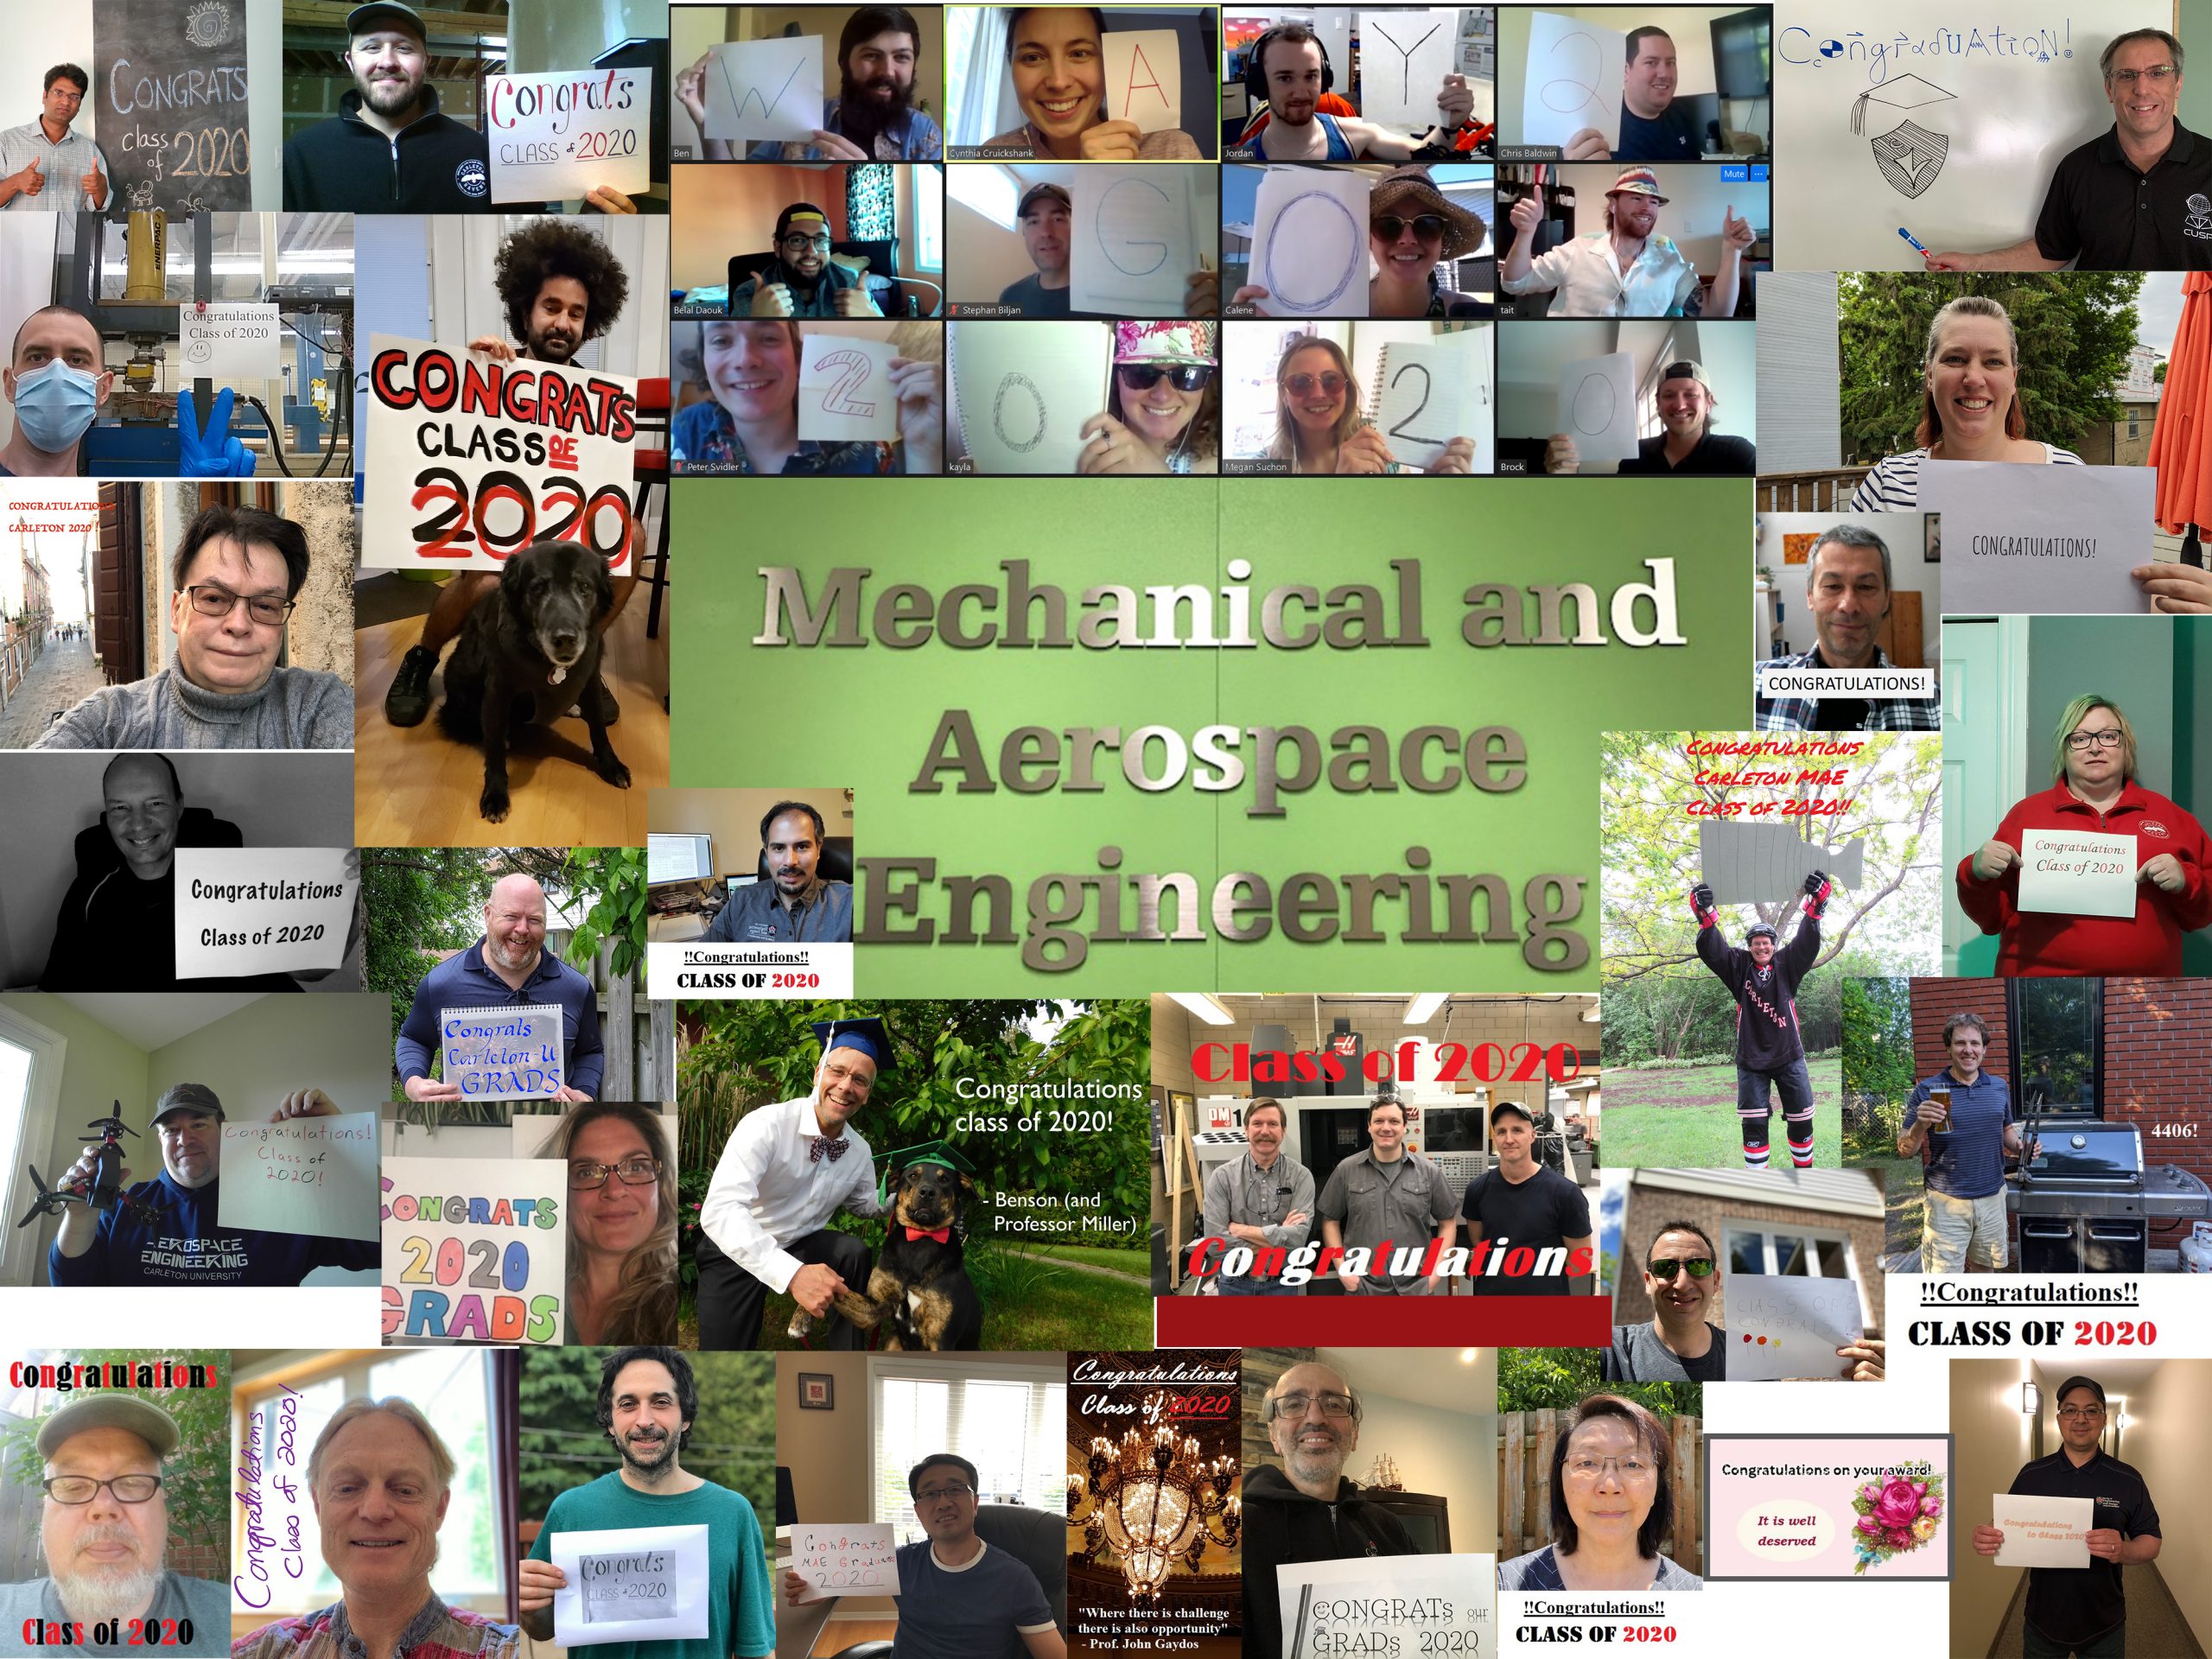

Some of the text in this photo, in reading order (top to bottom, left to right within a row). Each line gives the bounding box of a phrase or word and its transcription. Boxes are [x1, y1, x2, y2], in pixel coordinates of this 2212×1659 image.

[1372, 22, 1441, 105] Y
[1541, 32, 1611, 116] 2
[110, 58, 248, 114] CONGRATS
[721, 55, 806, 119] W
[1125, 44, 1170, 118] A
[492, 69, 636, 134] Congrats
[122, 124, 168, 151] class
[500, 129, 637, 164] CLASS of 2020
[172, 127, 251, 177] 2020
[949, 149, 1033, 159] Cynthia Cruickshank
[1225, 149, 1254, 157] Jordan
[1501, 149, 1557, 157] Chris Baldwin
[147, 150, 164, 181] of
[1724, 169, 1745, 178] Mute
[1096, 178, 1170, 276] G
[183, 309, 275, 326] Congratulations
[674, 306, 722, 315] Belal Daouk
[963, 306, 1021, 317] Stephan Biljan
[1225, 306, 1254, 315] Calene
[1500, 306, 1515, 315] tait
[189, 327, 269, 339] Class of 2020
[814, 350, 876, 417] 2
[372, 349, 636, 443] CONGRATS
[1389, 363, 1447, 448] 2
[417, 422, 580, 466] CLASS OF
[949, 463, 970, 473] kayla
[1225, 463, 1287, 473] Megan Suchon
[411, 467, 632, 569] 2020
[1973, 535, 2097, 558] CONGRATULATIONS!
[753, 556, 1688, 650] Mechanical and
[909, 709, 1529, 819] Aerospace
[2035, 840, 2126, 855] Congratulations
[2037, 859, 2124, 876] Class of 2020
[192, 879, 343, 903] Congratulations
[855, 844, 1590, 974] Engineering
[200, 925, 325, 946] Class of 2020
[1745, 980, 1787, 1027] CARLETON
[444, 1017, 532, 1052] Congrats
[461, 1068, 561, 1095] GRADS
[225, 1122, 372, 1141] Congratulations!
[258, 1146, 326, 1165] Class of
[266, 1166, 323, 1187] 2020!
[141, 1250, 249, 1268] ENGINEERING
[400, 1236, 530, 1293] 2020
[143, 1267, 242, 1281] CARLETON UNIVERSITY
[1722, 1464, 1932, 1478] Congratulations on your award!
[1758, 1516, 1816, 1526] It is well
[804, 1534, 886, 1552] Congrats
[1758, 1536, 1816, 1547] deserved
[581, 1550, 664, 1584] Congrats
[802, 1556, 827, 1567] MAE
[815, 1569, 879, 1587] 2020
[588, 1582, 667, 1600] CLASS 2020
[1420, 1630, 1478, 1652] 2020
